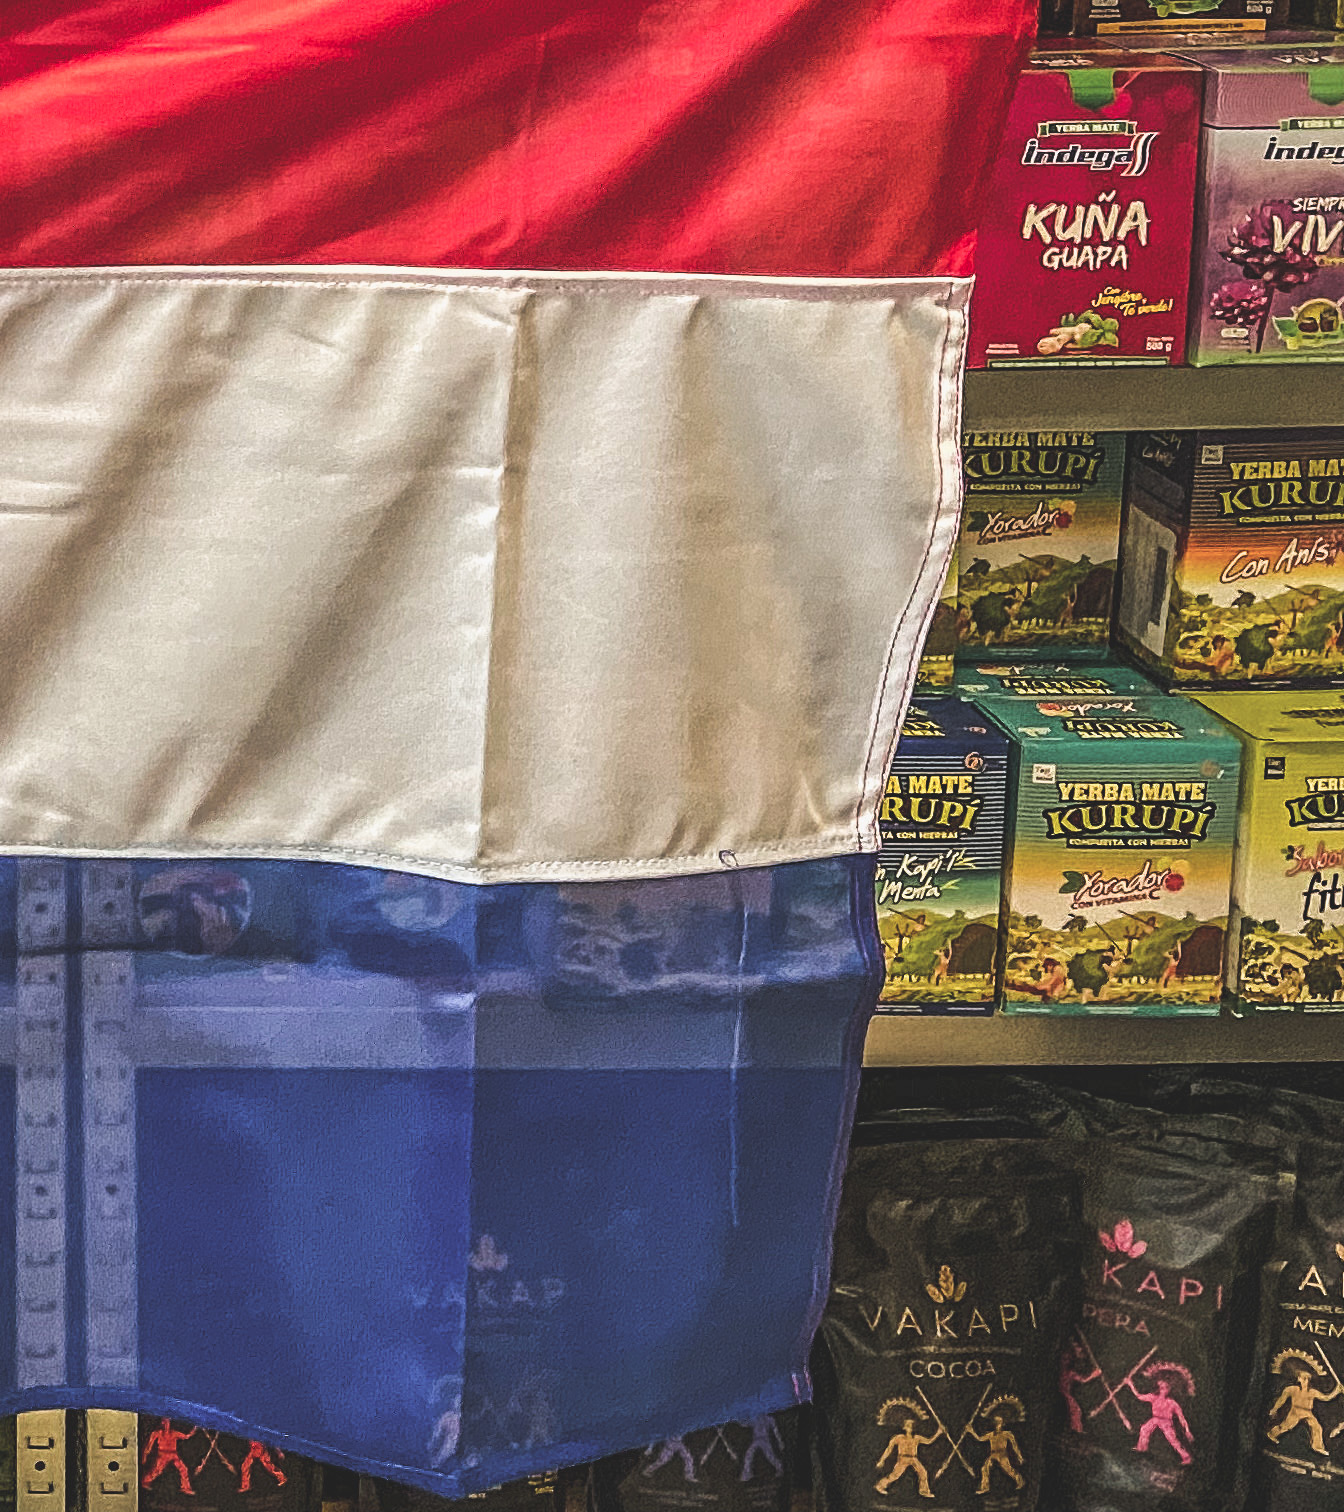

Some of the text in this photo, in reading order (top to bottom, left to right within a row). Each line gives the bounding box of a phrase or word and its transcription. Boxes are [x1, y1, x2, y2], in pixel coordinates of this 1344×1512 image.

[1022, 190, 1152, 247] KUÑA
[1042, 246, 1128, 270] GUAPA
[1223, 551, 1269, 578] Con
[909, 776, 973, 794] MATE
[1059, 782, 1205, 802] YERBA MATE
[1048, 803, 1213, 838] KURUPÍ
[879, 877, 940, 904] Menta
[863, 1302, 1037, 1340] VAKAPI
[909, 1360, 996, 1379] COCOA
